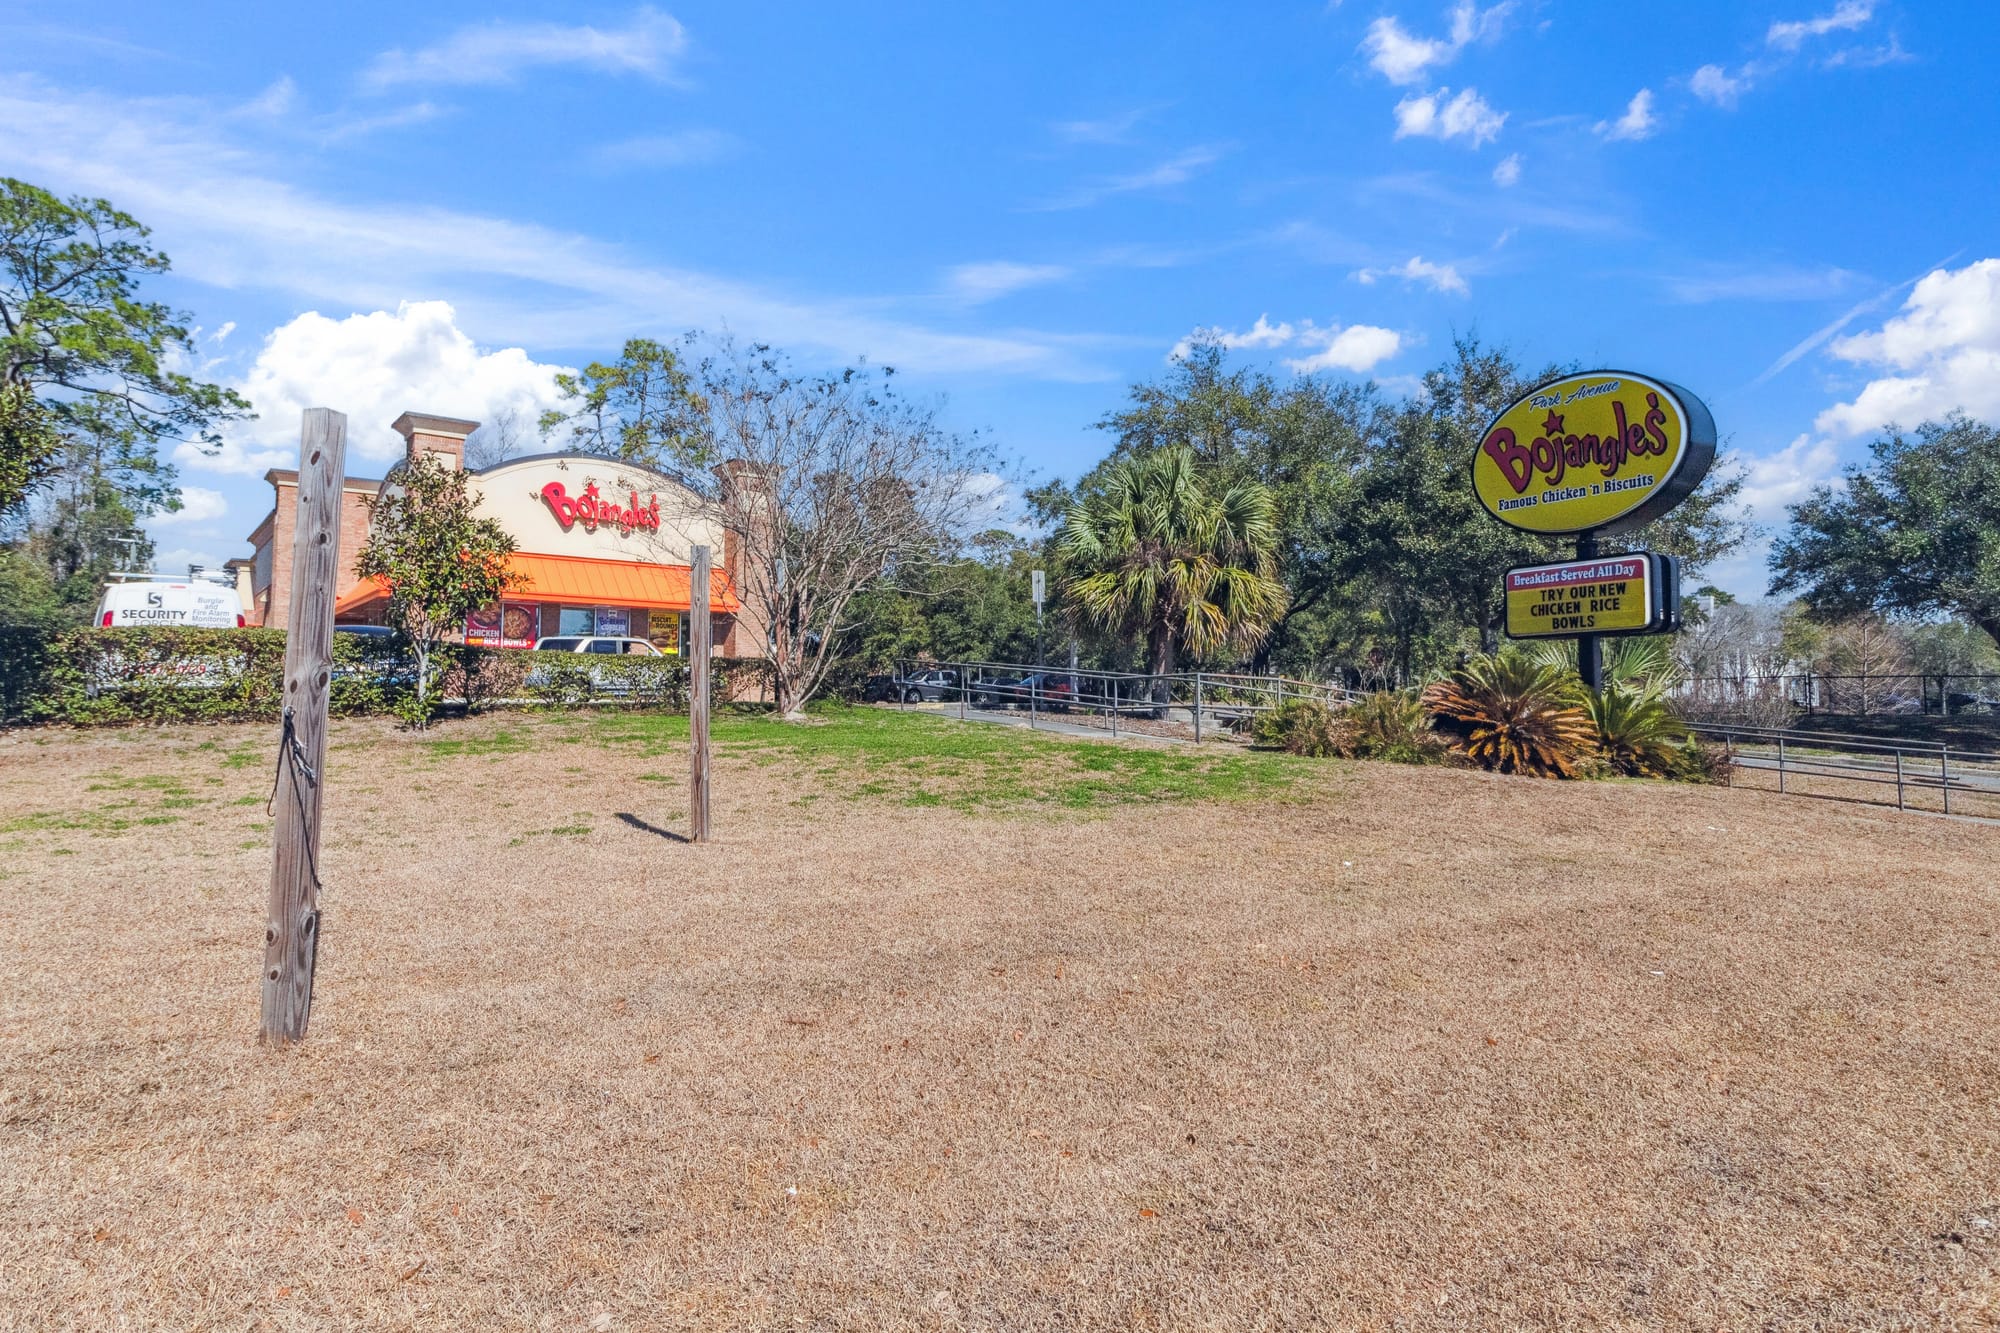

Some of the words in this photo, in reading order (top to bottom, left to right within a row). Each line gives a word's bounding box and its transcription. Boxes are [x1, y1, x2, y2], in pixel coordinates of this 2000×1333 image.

[1529, 392, 1560, 411] Park
[1565, 381, 1620, 404] Avenue
[1498, 495, 1537, 512] Famous
[1542, 486, 1586, 503] Chicken
[1604, 474, 1654, 493] Biscuits
[1514, 571, 1560, 586] Breakfast
[1561, 567, 1595, 581] Served
[1597, 565, 1613, 577] All
[1615, 564, 1636, 577] Day
[1540, 588, 1565, 602] TRY
[1570, 585, 1595, 600] OUR
[1599, 582, 1627, 597] NEW
[197, 597, 225, 605] Burglar
[1530, 602, 1581, 617] CHICKEN
[1590, 598, 1620, 612] RICE
[121, 609, 187, 619] SECURITY
[192, 616, 231, 624] Monitoring
[1552, 615, 1595, 630] BOWLS
[468, 628, 500, 637] CHICKEN
[483, 637, 500, 645] RICE
[503, 639, 527, 647] BOWLS
